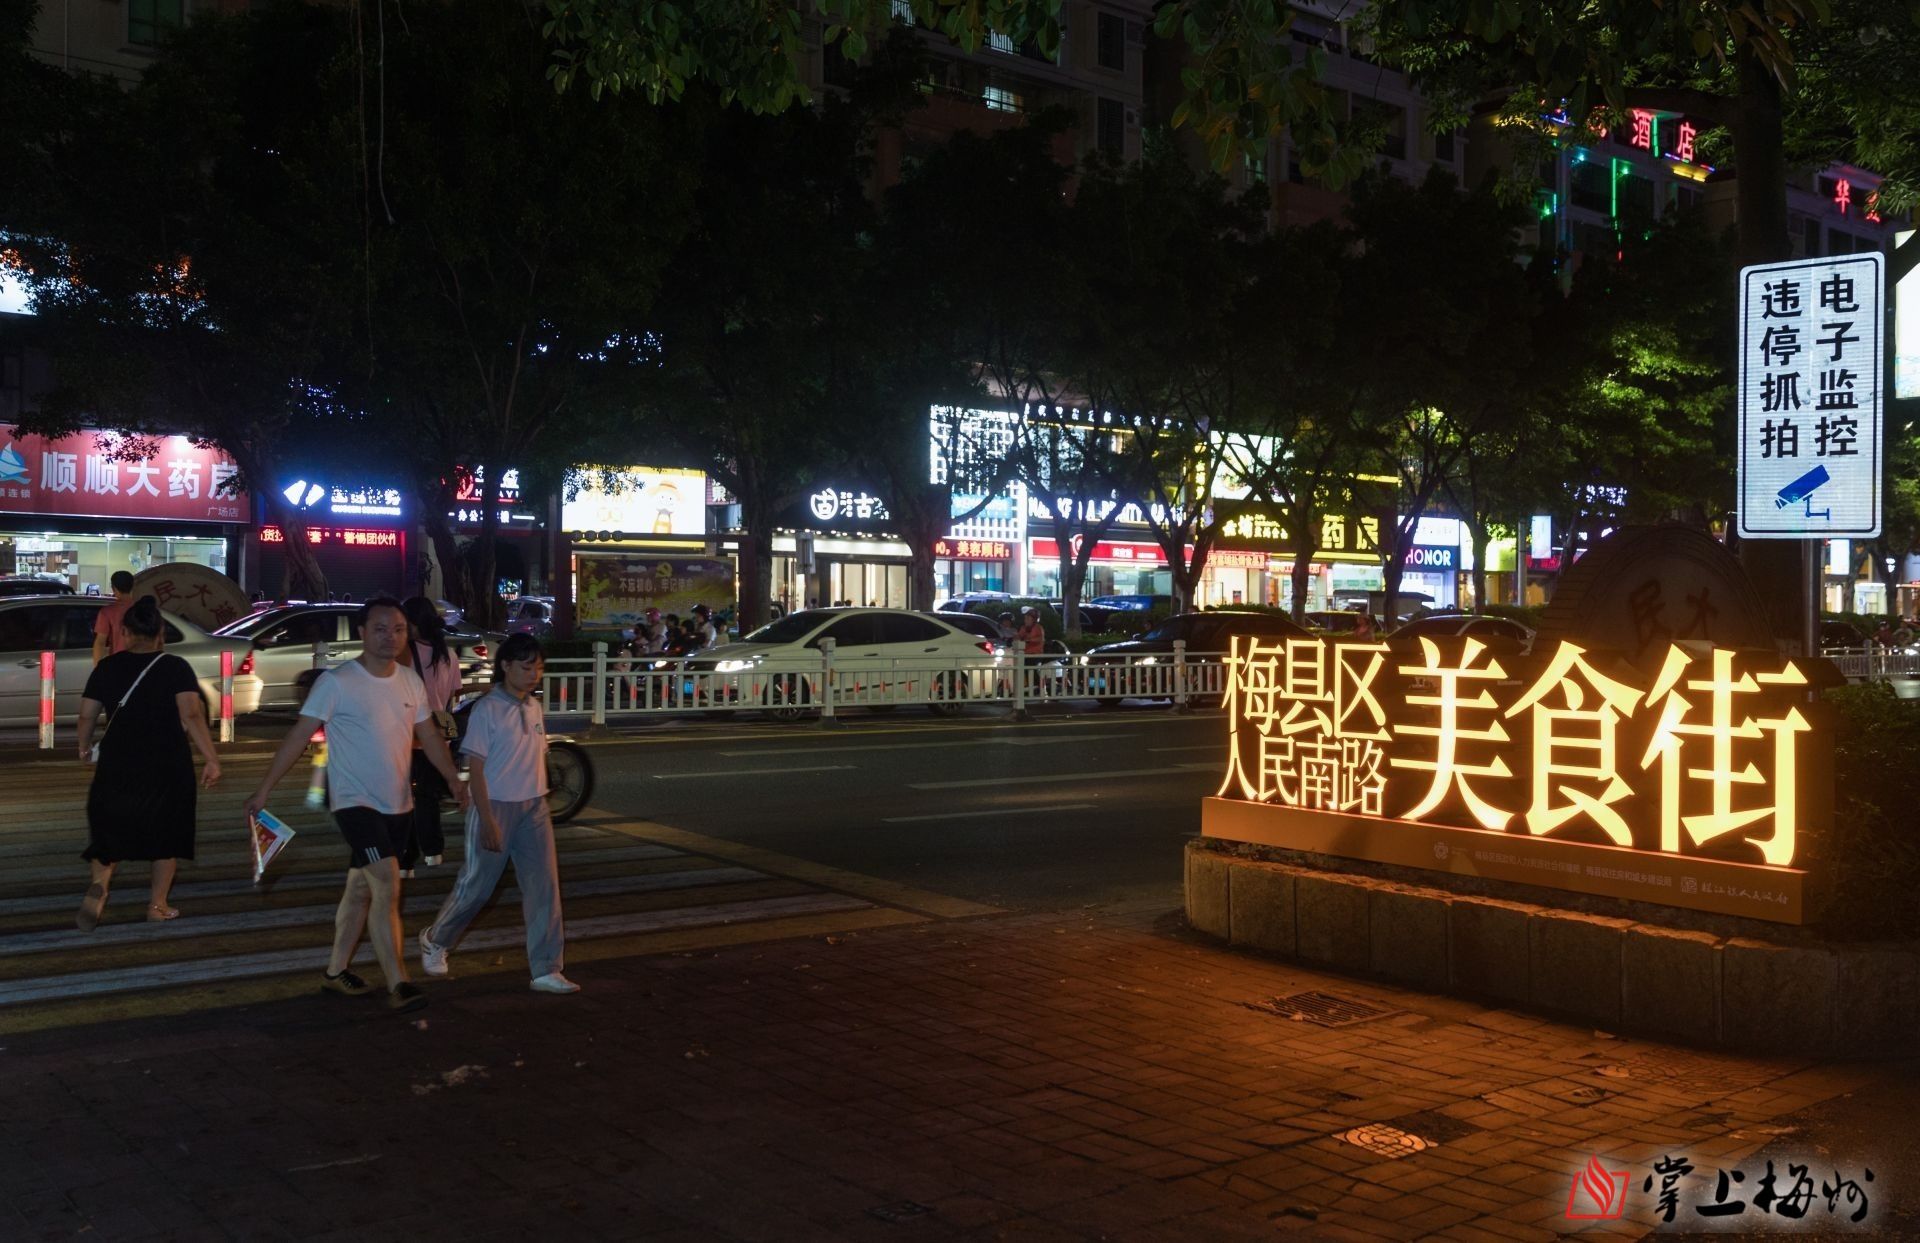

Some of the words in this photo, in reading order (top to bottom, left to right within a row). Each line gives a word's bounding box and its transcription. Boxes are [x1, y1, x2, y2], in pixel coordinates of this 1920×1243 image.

[1759, 278, 1803, 459] 违停抓拍
[1814, 273, 1860, 457] 电子监控
[40, 450, 239, 502] 顺顺大药房
[207, 506, 239, 518] 广场店
[1321, 514, 1379, 550] 药房
[1405, 547, 1452, 567] HONOR
[1221, 634, 1394, 742] 梅县区
[1216, 730, 1389, 817] 人民南路
[1389, 636, 1812, 868] 美食街
